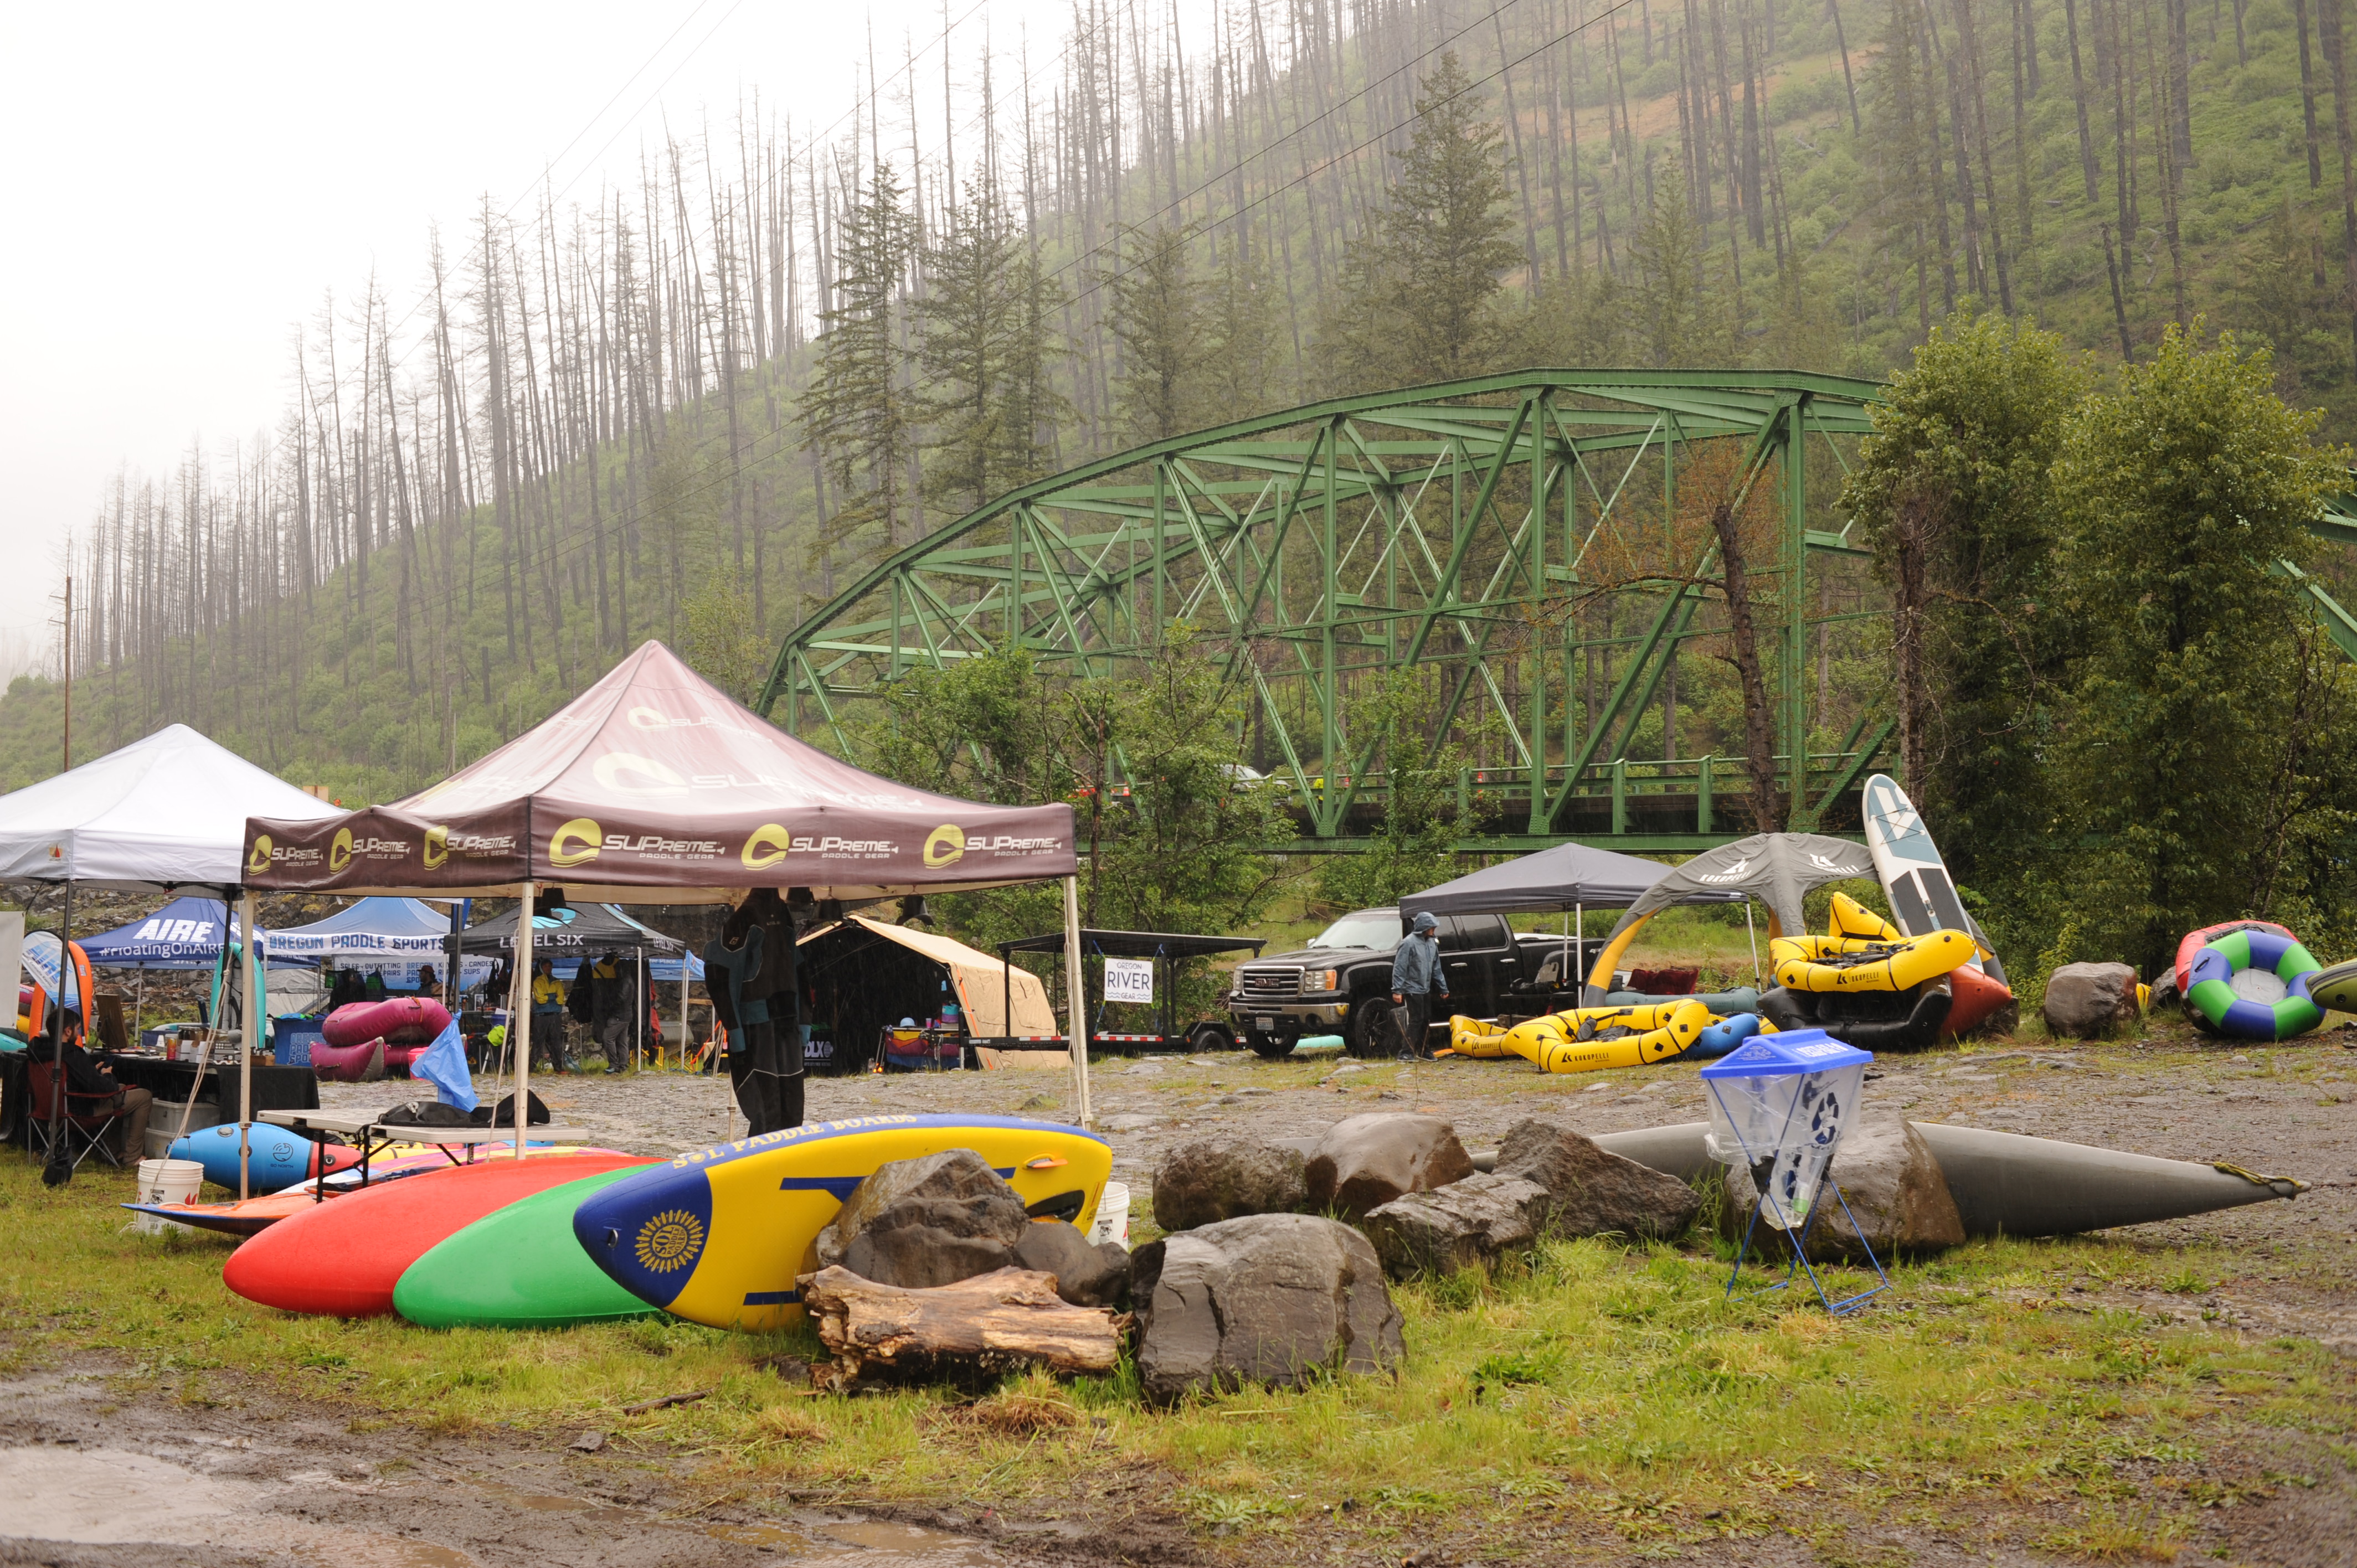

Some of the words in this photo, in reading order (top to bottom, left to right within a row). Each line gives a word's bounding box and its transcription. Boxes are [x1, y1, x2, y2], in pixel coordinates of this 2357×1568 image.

[133, 919, 214, 942] AIRE
[269, 936, 323, 949] OREGON
[331, 934, 385, 948] PADDLE
[391, 938, 445, 950] SPORTS
[500, 934, 553, 948] LEEL
[557, 934, 584, 946] SIX
[1108, 971, 1150, 990] RIVER
[1255, 978, 1279, 987] GMC
[1574, 1052, 1609, 1061] KOKOPELLI
[731, 1123, 825, 1152] PADDLE
[829, 1114, 917, 1131] BOARDS
[655, 1227, 673, 1254] SOL
[667, 1227, 680, 1254] PADDLE
